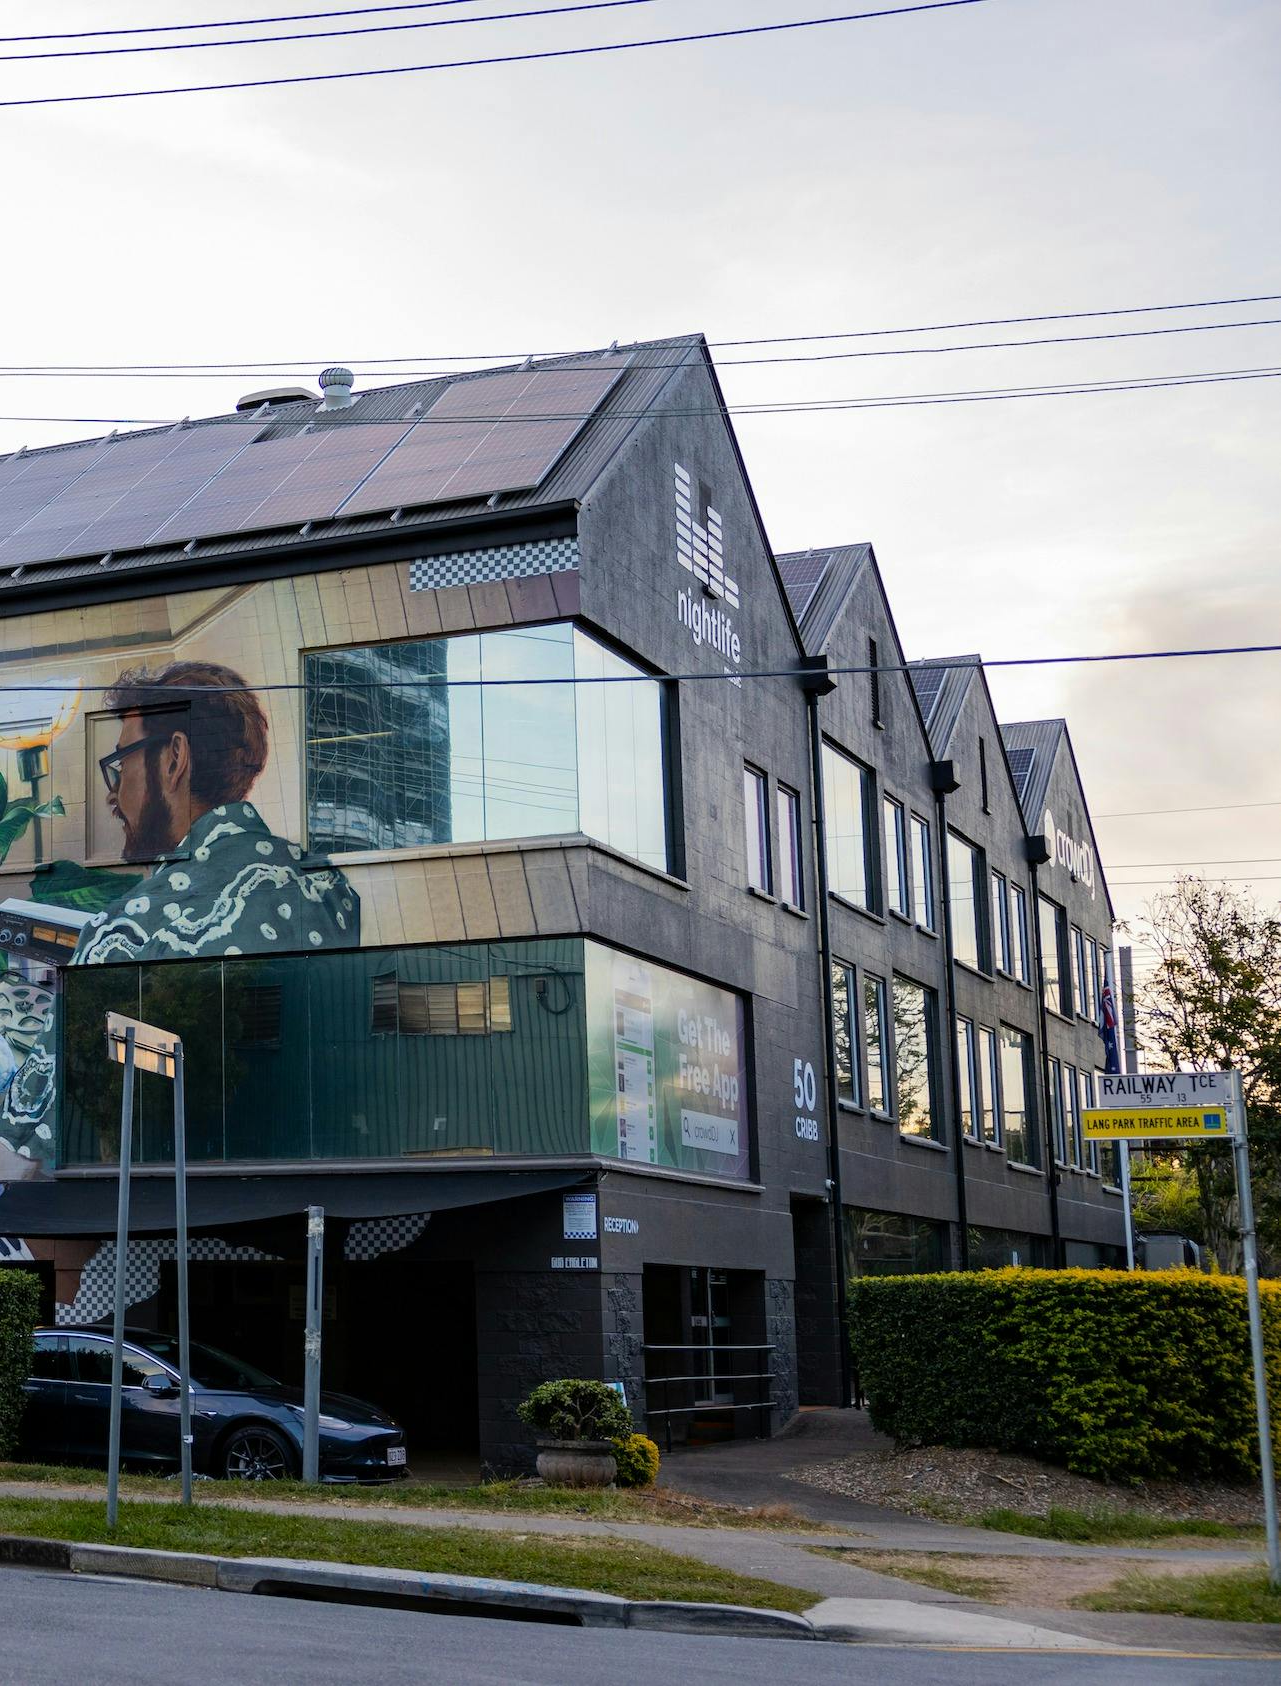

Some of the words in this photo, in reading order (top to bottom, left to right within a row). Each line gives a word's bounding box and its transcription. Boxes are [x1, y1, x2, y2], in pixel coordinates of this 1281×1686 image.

[677, 587, 741, 664] nightlife
[678, 1008, 703, 1049] Get
[704, 1016, 731, 1056] The
[678, 1053, 710, 1095] Free
[713, 1063, 739, 1111] App
[793, 1058, 816, 1111] 50
[1103, 1076, 1177, 1095] RAILWAY
[1189, 1075, 1217, 1093] TCE
[1140, 1094, 1152, 1103] 55
[1178, 1093, 1187, 1102] 13
[795, 1116, 819, 1141] CRIBB
[1087, 1118, 1110, 1130] LANG
[1112, 1117, 1135, 1129] PARK
[1138, 1116, 1173, 1128] TRAFFIC
[1176, 1115, 1199, 1127] AREA
[604, 1216, 636, 1234] RECEPTION
